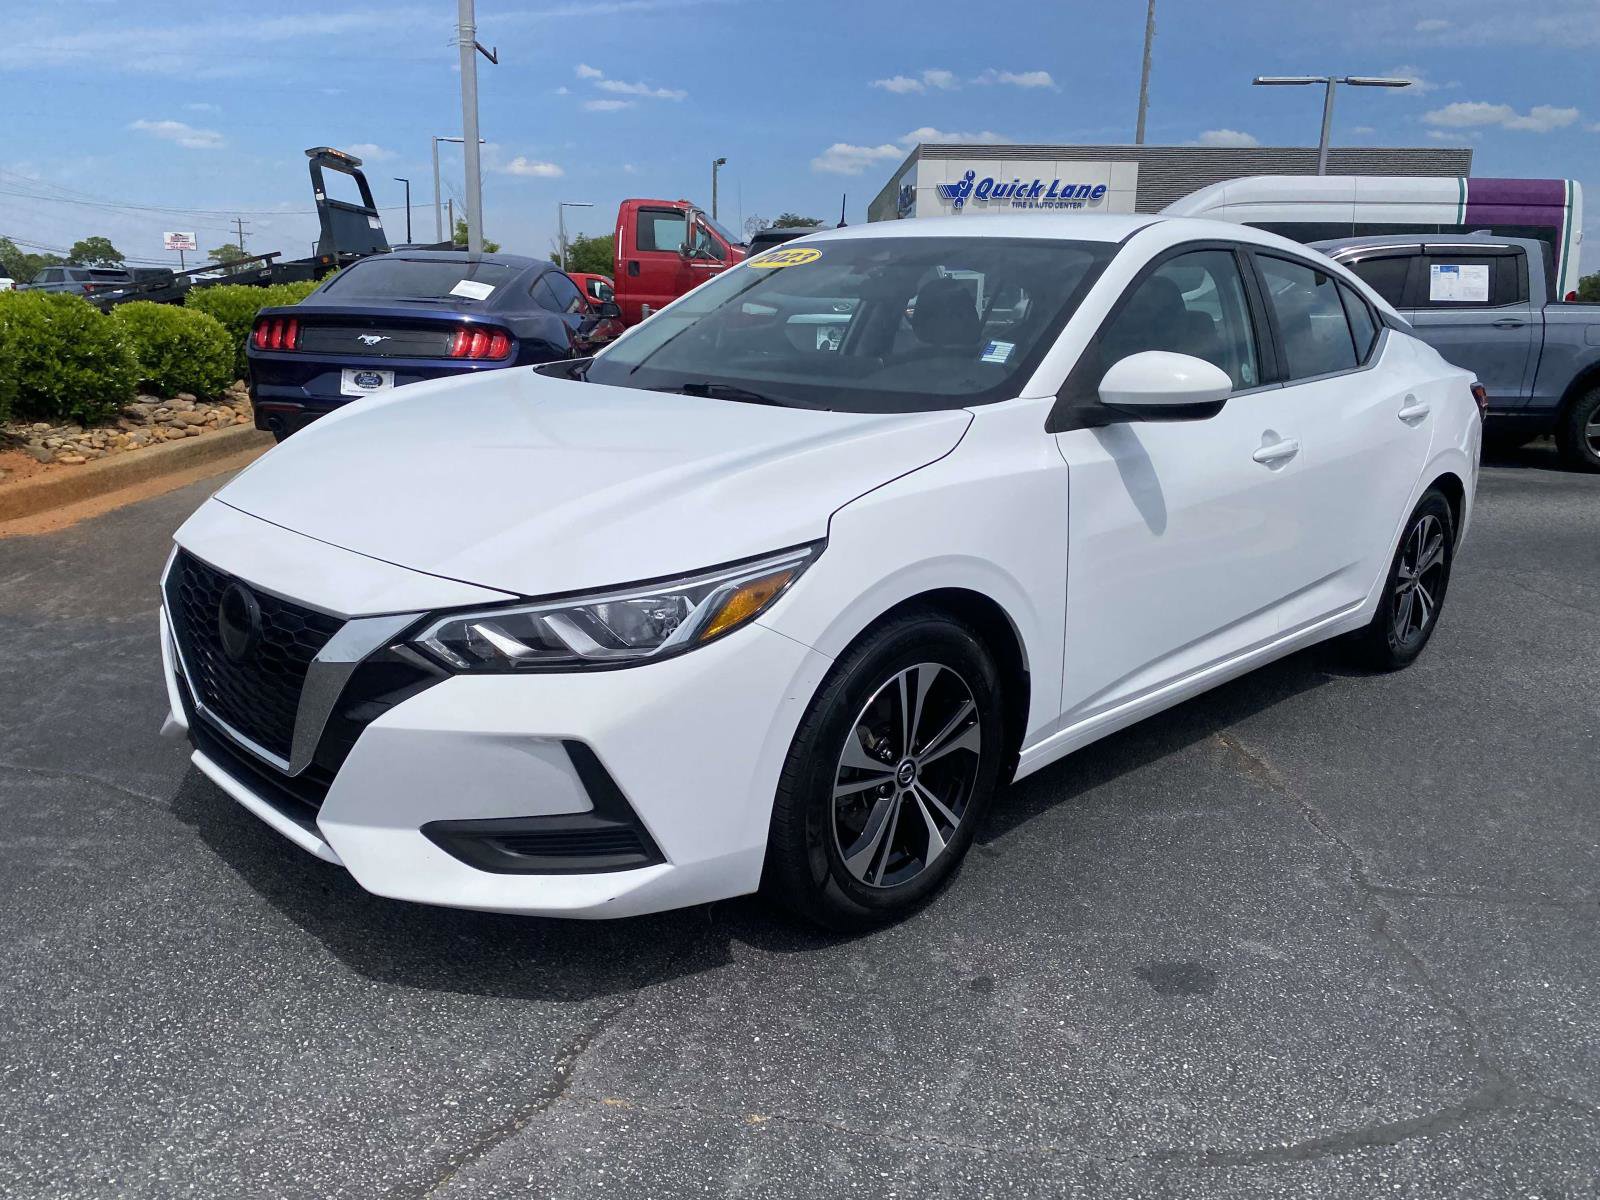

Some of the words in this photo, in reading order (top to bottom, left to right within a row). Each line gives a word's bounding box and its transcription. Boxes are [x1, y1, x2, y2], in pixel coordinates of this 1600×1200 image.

[974, 177, 1044, 200] Quick
[1045, 179, 1107, 199] Lane
[1054, 201, 1082, 209] CENTER
[752, 253, 817, 263] 2023
